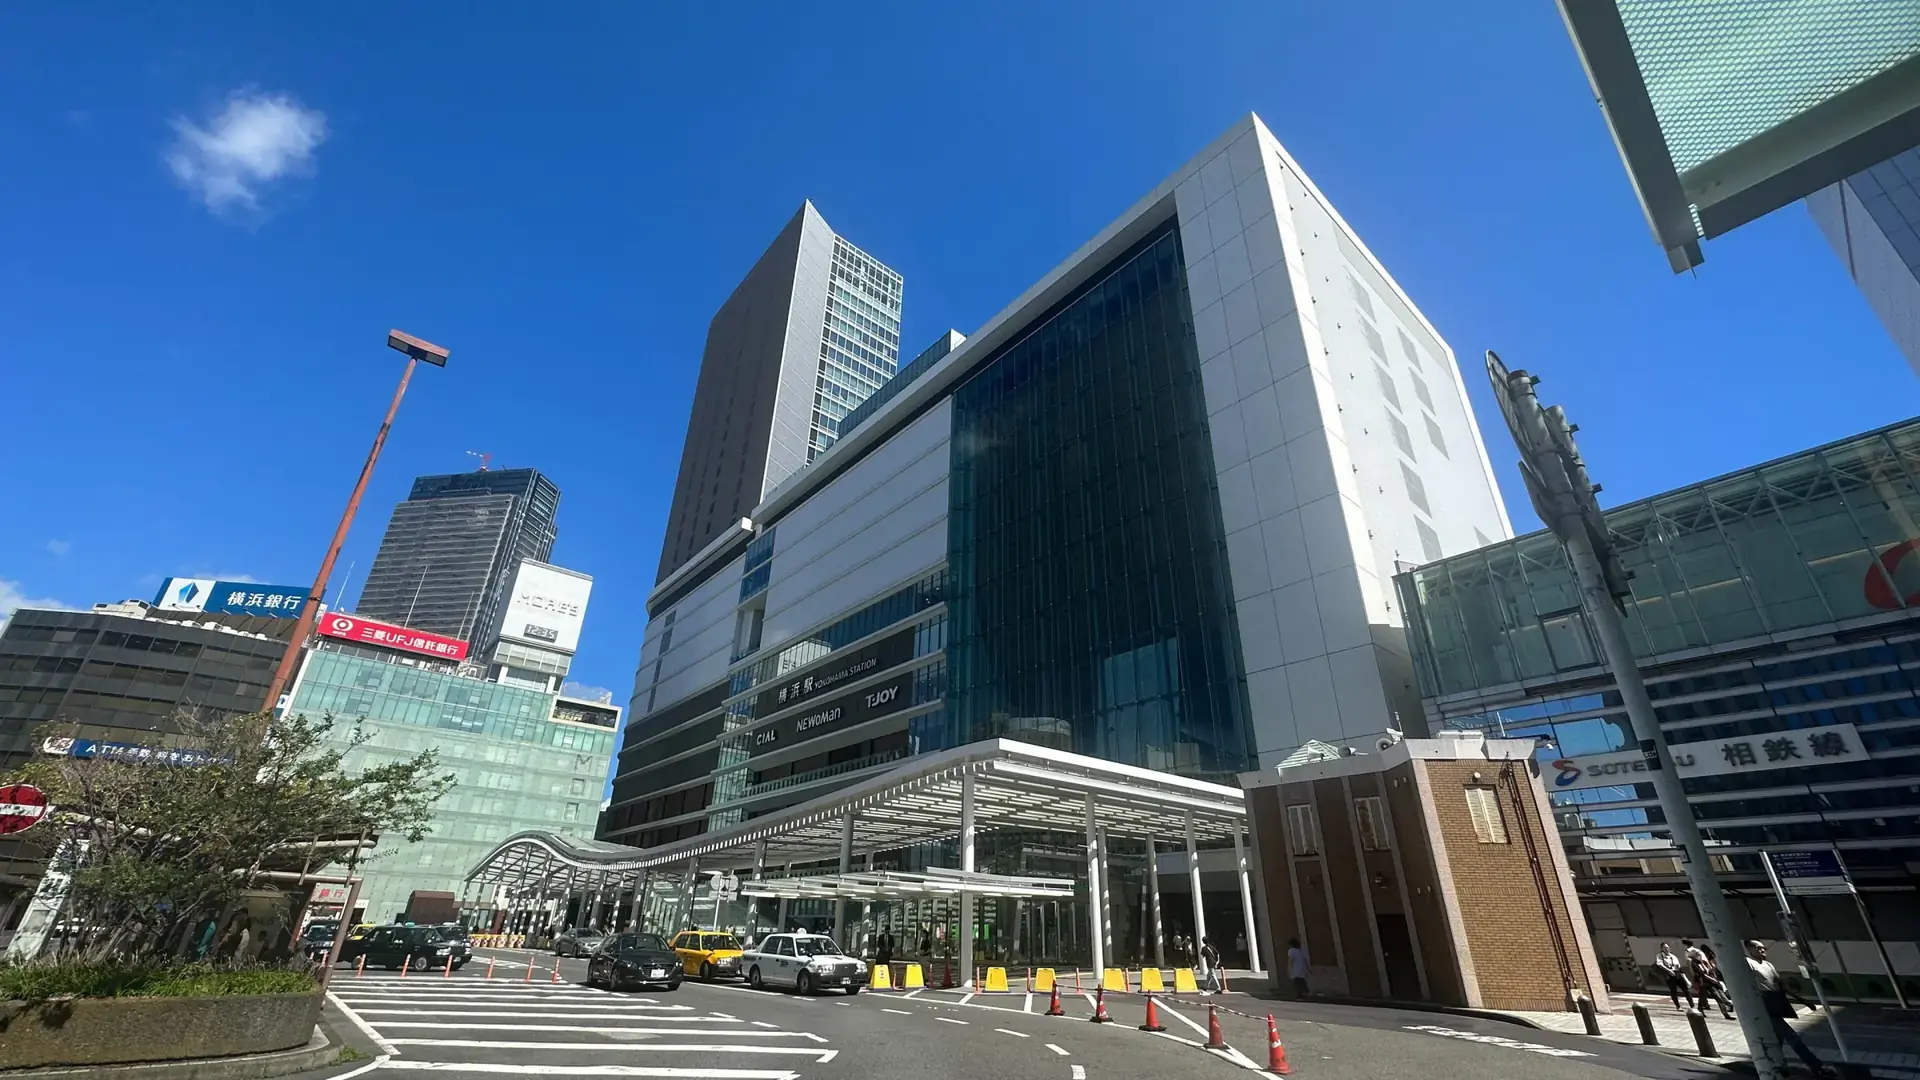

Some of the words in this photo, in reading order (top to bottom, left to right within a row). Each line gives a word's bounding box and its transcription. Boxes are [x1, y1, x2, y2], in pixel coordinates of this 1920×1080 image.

[227, 591, 301, 610] 横浜銀行
[361, 627, 459, 655] 三菱UFJ信託銀行
[778, 676, 814, 704] 横浜駅
[814, 670, 849, 689] YOKOHAMA
[849, 658, 877, 676] STATION
[756, 729, 776, 746] CIAL
[1721, 731, 1850, 767] 相鉄線
[575, 754, 593, 773] M
